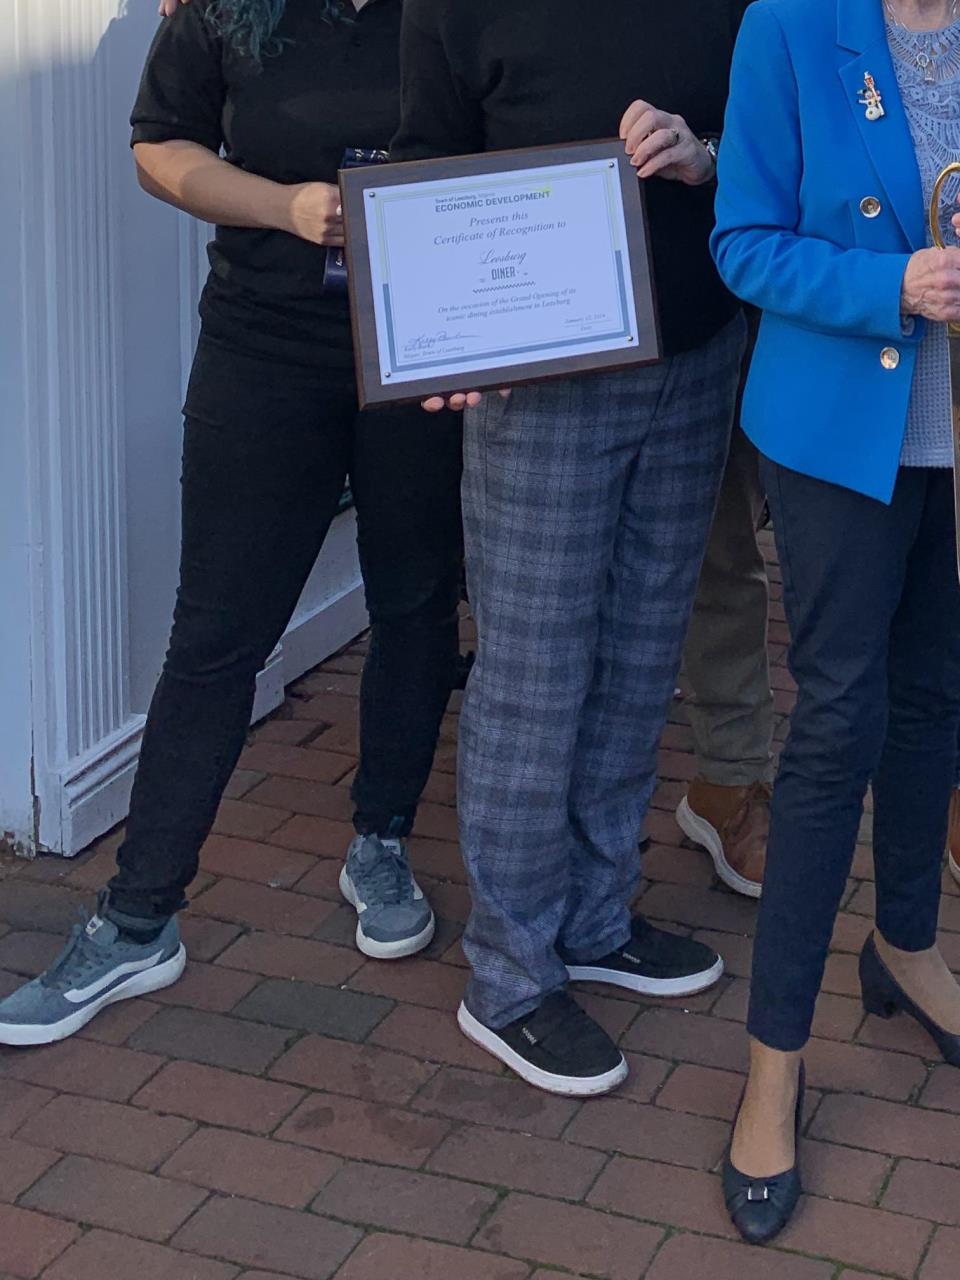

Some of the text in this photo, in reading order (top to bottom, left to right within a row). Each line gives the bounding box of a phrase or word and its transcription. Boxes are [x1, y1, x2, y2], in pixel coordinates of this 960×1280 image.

[435, 199, 483, 213] ECONOMIC
[485, 191, 551, 207] DEVELOPMENT
[469, 212, 529, 227] Presents this
[433, 221, 567, 246] Certificate of Recognition to
[491, 266, 516, 281] DINER
